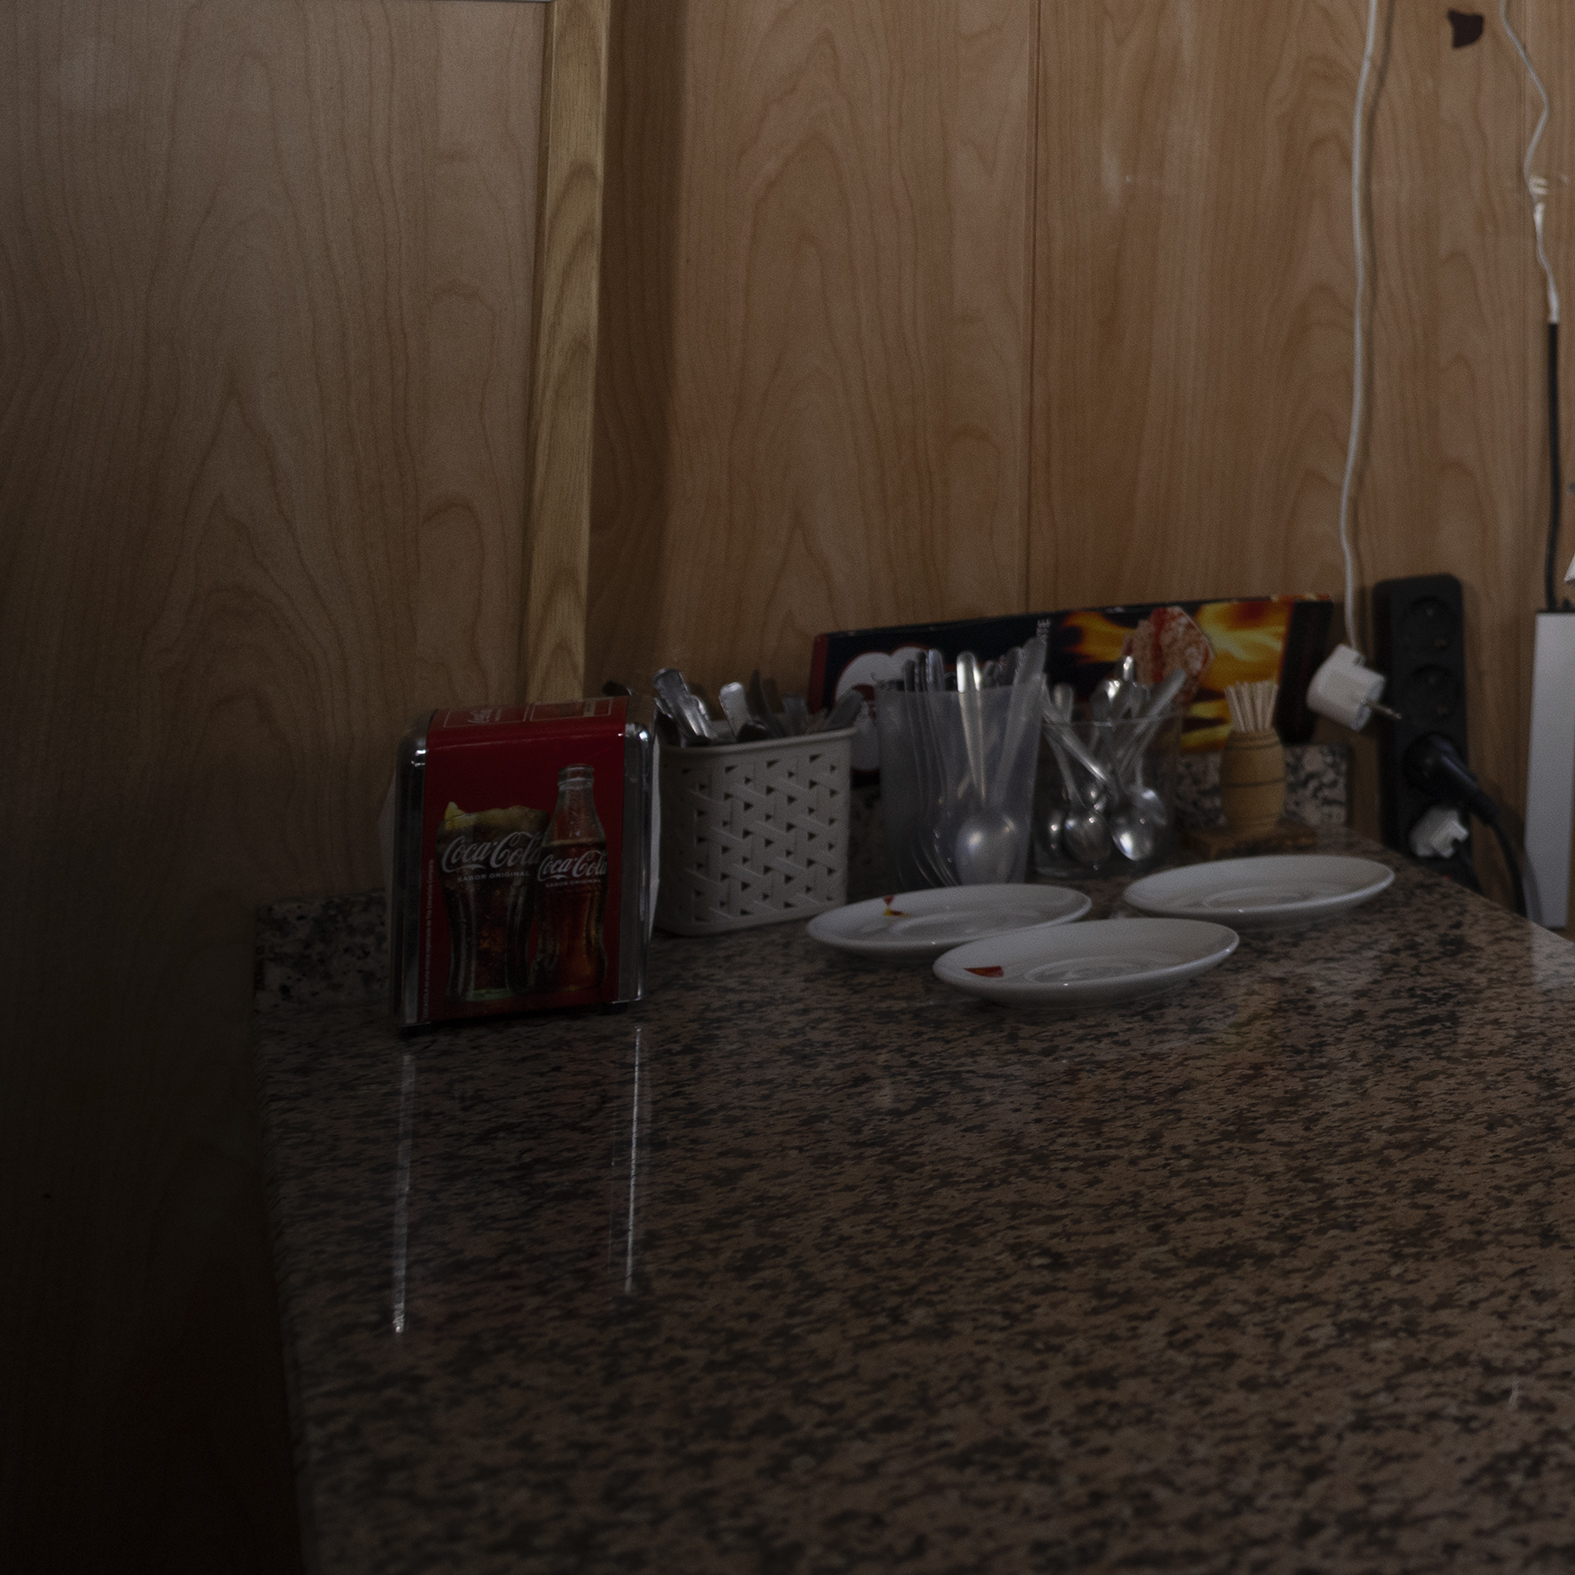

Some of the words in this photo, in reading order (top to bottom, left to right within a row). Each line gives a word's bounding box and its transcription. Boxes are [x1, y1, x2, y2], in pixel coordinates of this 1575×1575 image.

[440, 831, 545, 874] Coca-Cola
[537, 849, 608, 883] Coca-Cola
[456, 873, 488, 884] SABOR
[488, 870, 531, 881] ORIGINAL
